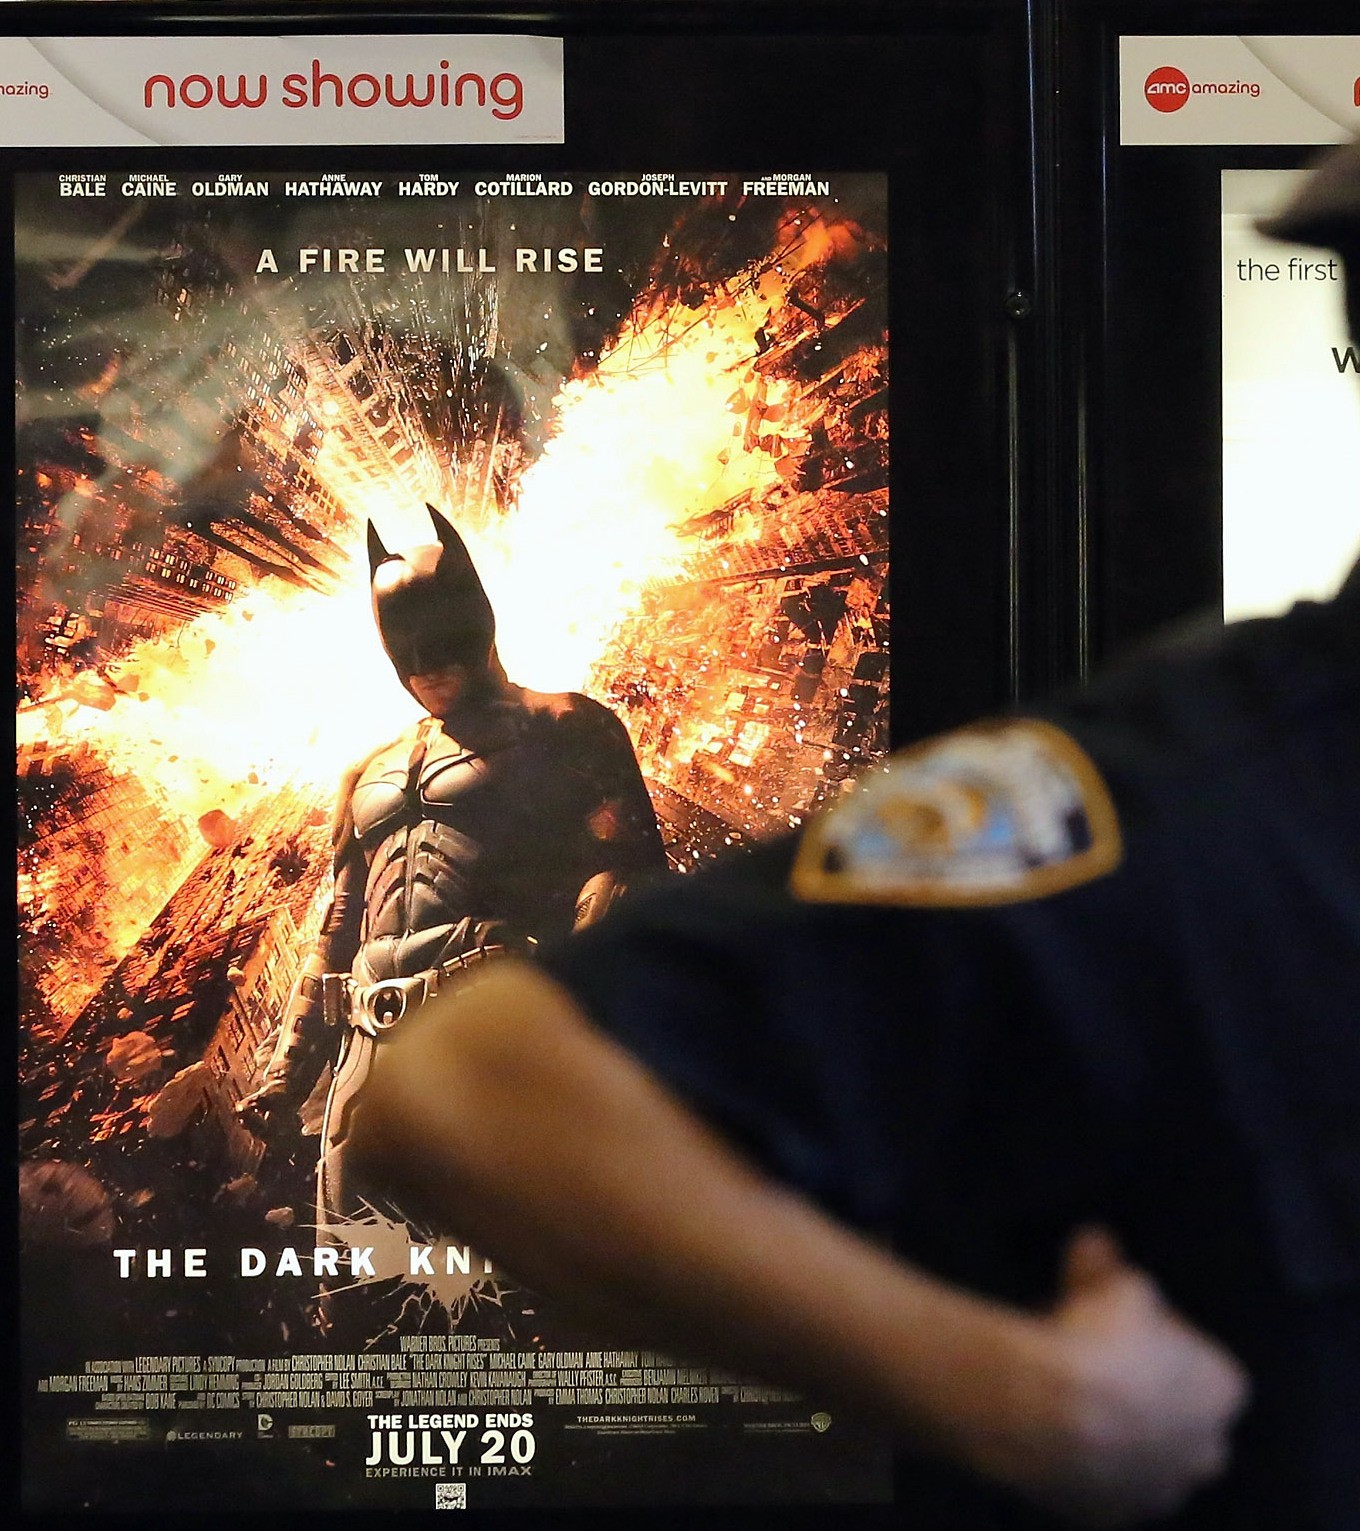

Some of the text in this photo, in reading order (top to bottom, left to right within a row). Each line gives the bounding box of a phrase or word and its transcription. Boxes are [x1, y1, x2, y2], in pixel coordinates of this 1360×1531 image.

[0, 81, 49, 99] azing
[144, 59, 523, 120] now showing
[1192, 80, 1260, 97] amazing
[59, 174, 106, 182] CHRISTIAN
[129, 174, 169, 182] MICHAEL
[218, 174, 243, 182] GARY
[321, 174, 346, 182] ANNE
[419, 174, 439, 182] TOM
[506, 174, 542, 182] MARION
[641, 173, 674, 181] JOSEPH
[60, 183, 106, 196] BALE
[121, 182, 177, 196] CAINE
[191, 182, 269, 196] OLDMAN
[285, 182, 382, 196] HATHAWAY
[399, 181, 459, 196] HARDY
[474, 181, 573, 196] COTILLARD
[588, 181, 728, 196] GORDON-LEVITT
[743, 181, 829, 196] FREEMAN
[256, 249, 604, 273] A FIRE WILL RISE
[1237, 258, 1338, 281] the first
[113, 1249, 208, 1278] THE
[241, 1247, 376, 1277] DARK
[292, 1355, 333, 1371] CHRISTOPHER
[334, 1354, 355, 1371] NOLAN
[358, 1354, 390, 1371] CHRISTIAN
[391, 1354, 407, 1370] BALE
[490, 1353, 516, 1369] MICHAEL
[538, 1353, 555, 1369] GARY
[556, 1352, 583, 1369] OLDMAN
[340, 1373, 350, 1389] LEE
[256, 1392, 298, 1408] CHRISTOPHER
[367, 1414, 533, 1429] THE LEGEND ENDS
[178, 1432, 243, 1440] LEGENDARY
[366, 1430, 536, 1465] JULY 20
[366, 1466, 532, 1478] EXPERIENCE IT IN IMAX
